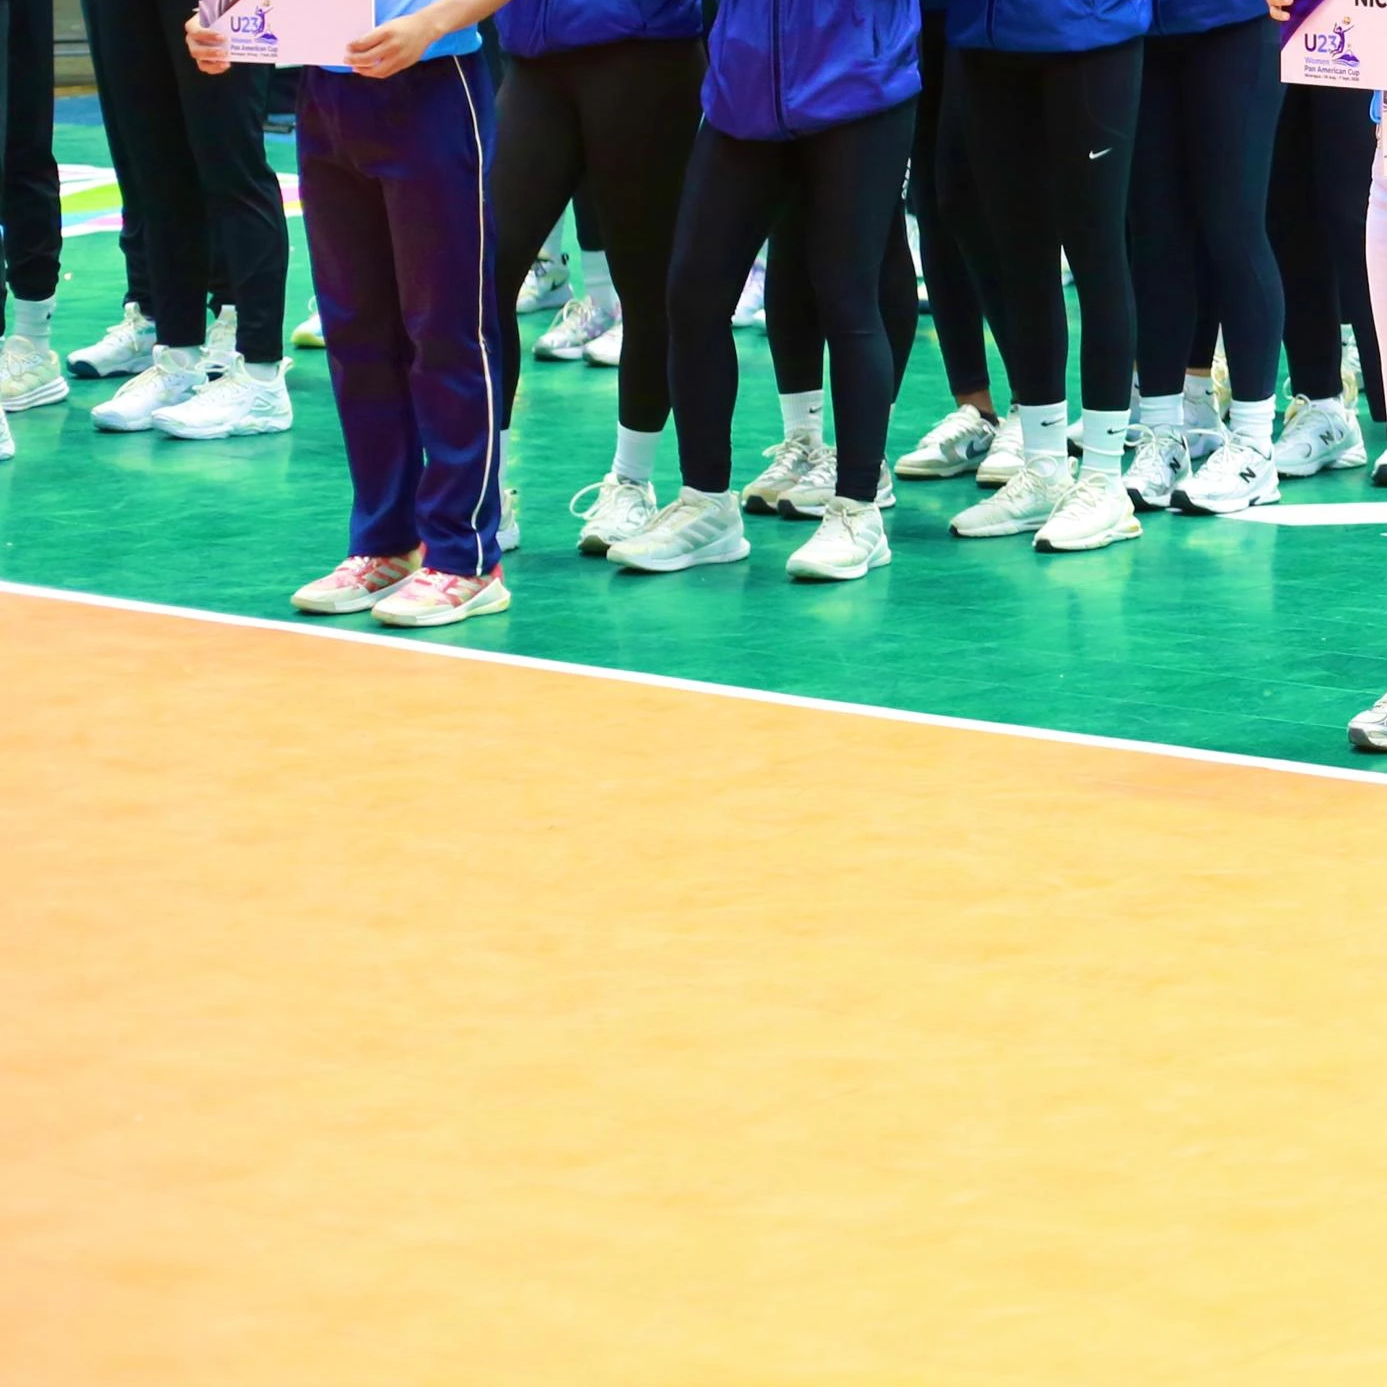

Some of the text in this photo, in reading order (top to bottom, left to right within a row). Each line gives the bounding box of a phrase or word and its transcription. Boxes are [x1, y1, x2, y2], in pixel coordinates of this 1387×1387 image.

[1305, 33, 1337, 52] U23
[1317, 66, 1347, 75] American
[1348, 68, 1360, 77] Cup
